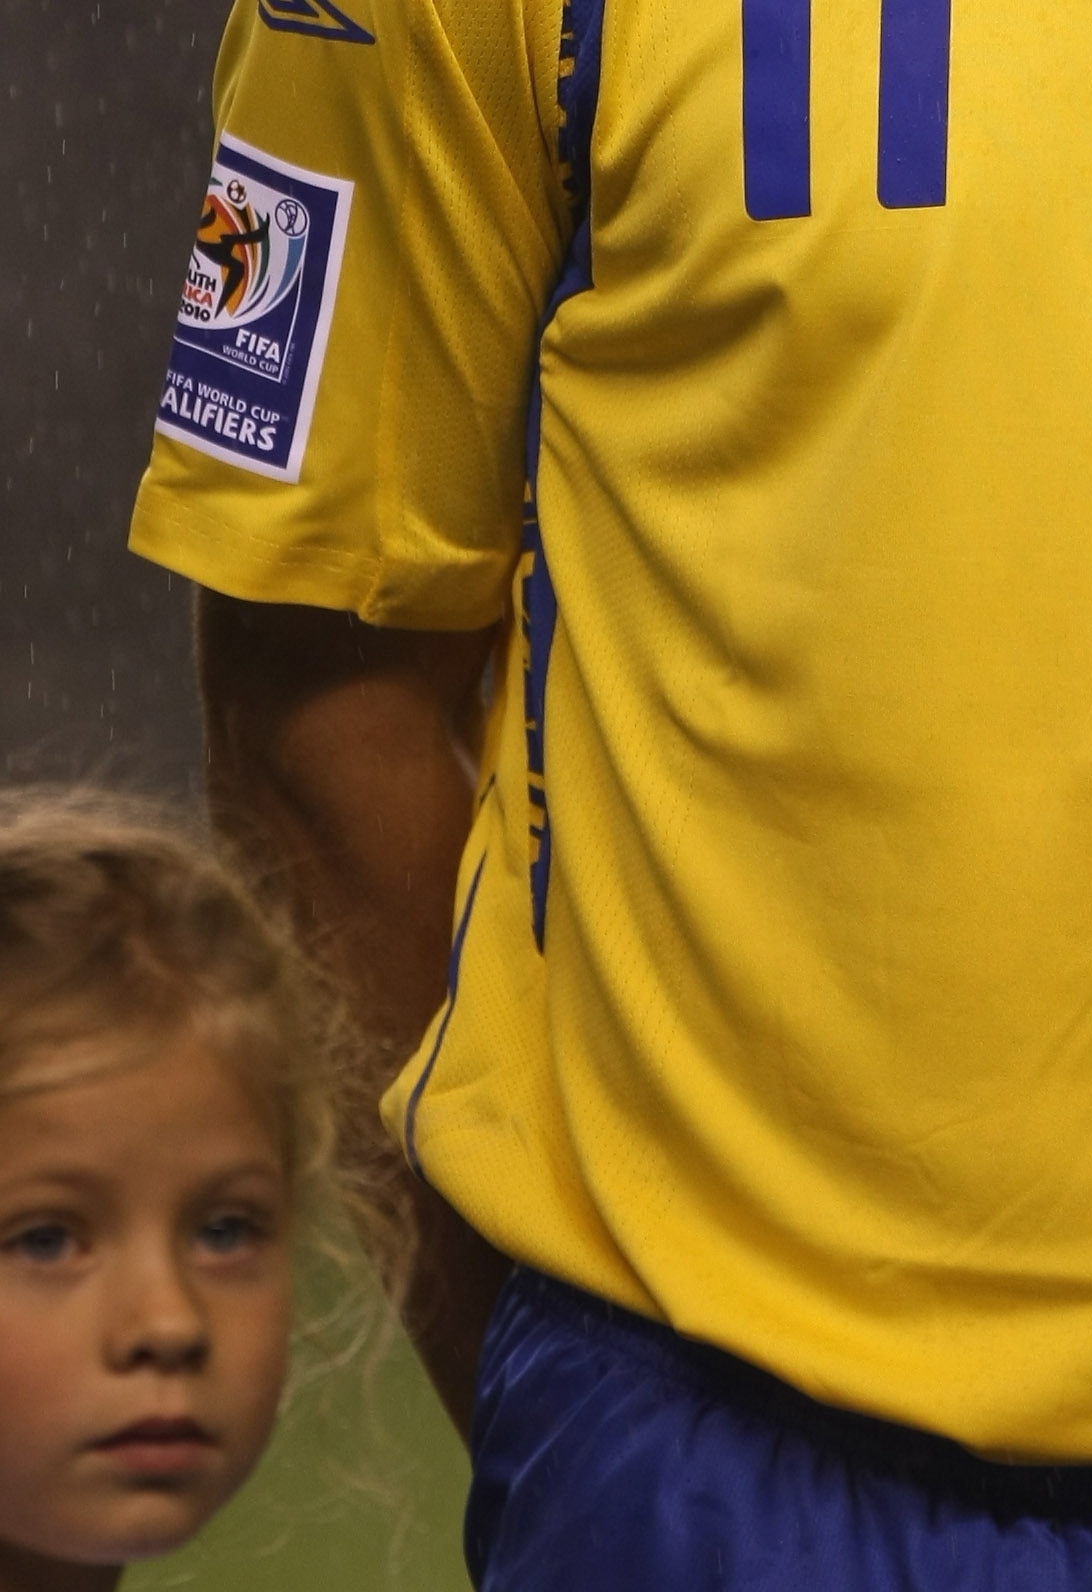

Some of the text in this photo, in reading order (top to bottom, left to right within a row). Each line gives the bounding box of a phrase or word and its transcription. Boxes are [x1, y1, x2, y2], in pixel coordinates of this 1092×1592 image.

[222, 344, 257, 366] WORLD
[259, 359, 280, 374] CUP
[235, 328, 281, 364] FIFA
[166, 369, 281, 425] FIFA WORLD CUP
